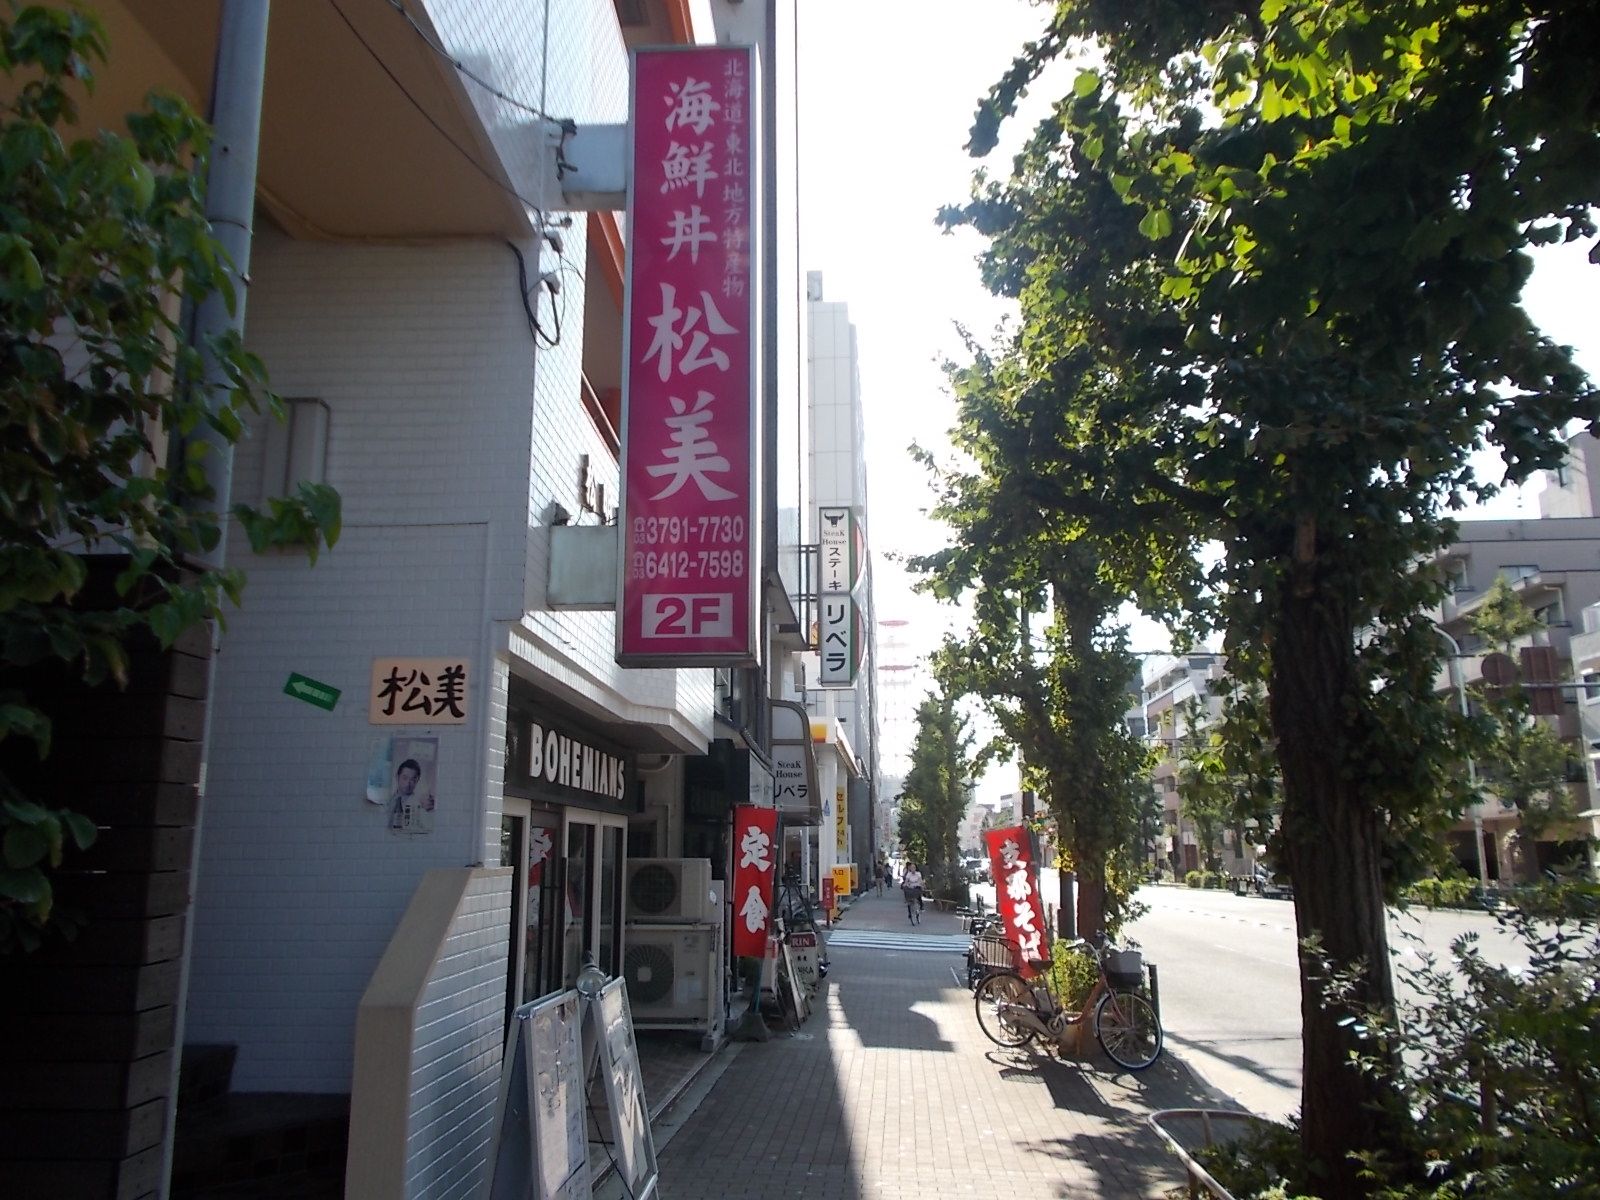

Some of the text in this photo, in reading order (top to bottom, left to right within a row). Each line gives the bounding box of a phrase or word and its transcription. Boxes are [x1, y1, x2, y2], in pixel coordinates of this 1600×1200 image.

[641, 282, 740, 501] 松美
[646, 515, 744, 544] 3791-7730
[646, 549, 744, 579] 6412-7598
[829, 547, 842, 591] ステーキ
[655, 597, 721, 635] 2F
[826, 604, 847, 672] リベラ
[377, 664, 466, 718] 松美
[529, 723, 625, 800] BOHEMIANS
[776, 770, 803, 778] House
[738, 825, 771, 934] 定食
